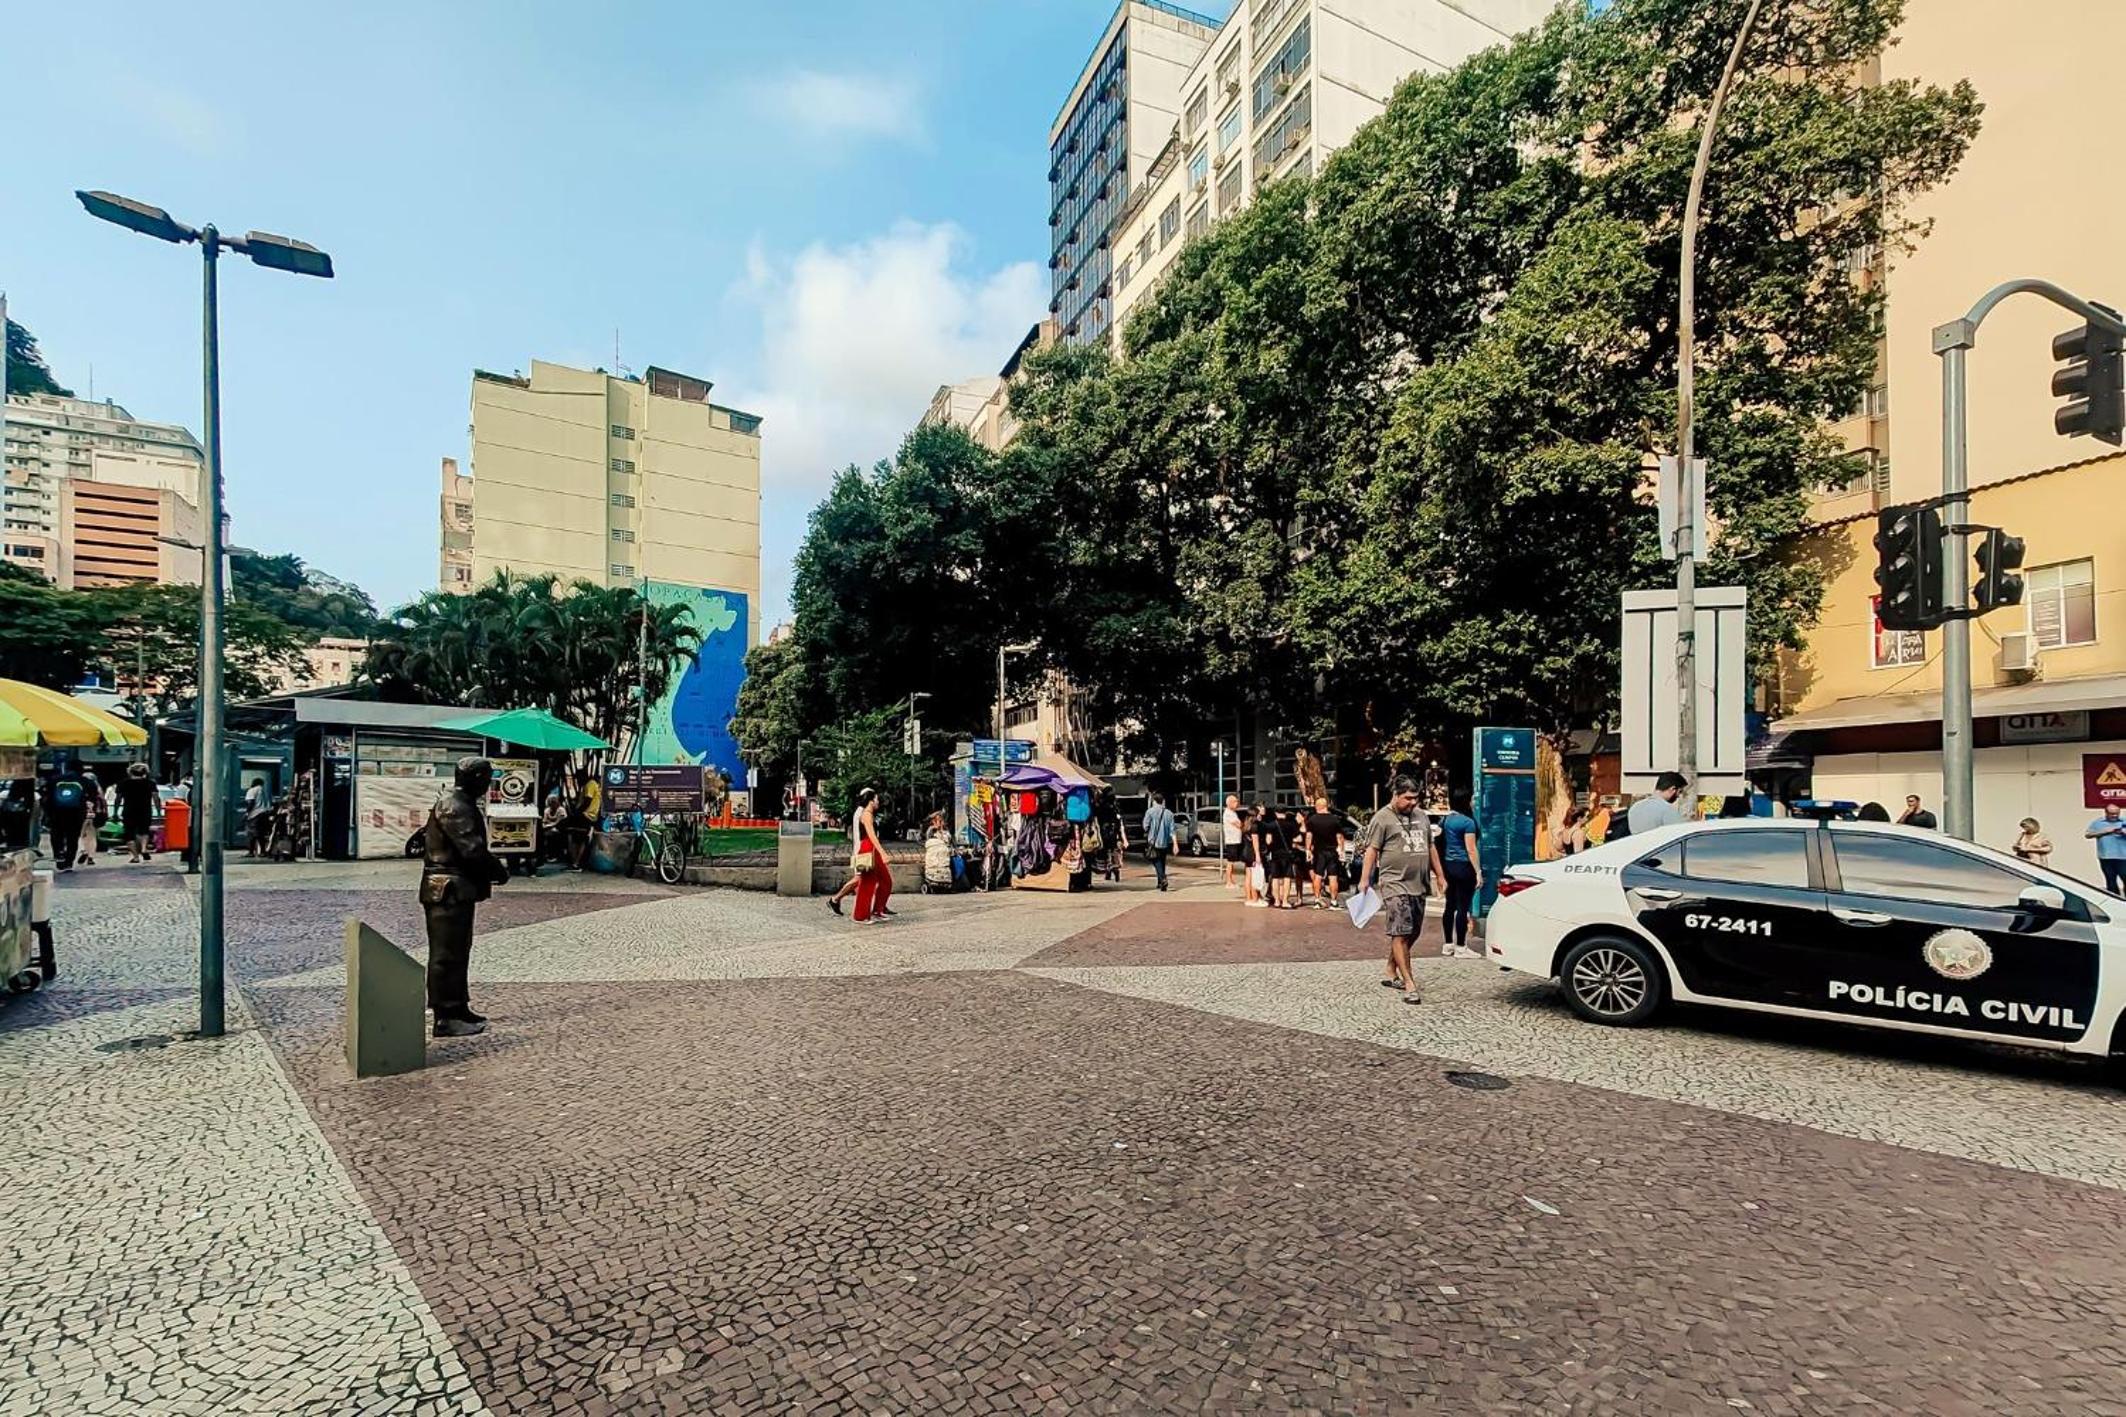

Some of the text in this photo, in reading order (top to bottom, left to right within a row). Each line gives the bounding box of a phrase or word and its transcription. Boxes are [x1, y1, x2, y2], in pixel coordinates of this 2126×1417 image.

[1564, 865, 1618, 875] DEAPTI
[1684, 913, 1772, 936] 67-2411
[1829, 980, 2086, 1030] POLÍCIA CIVIL
